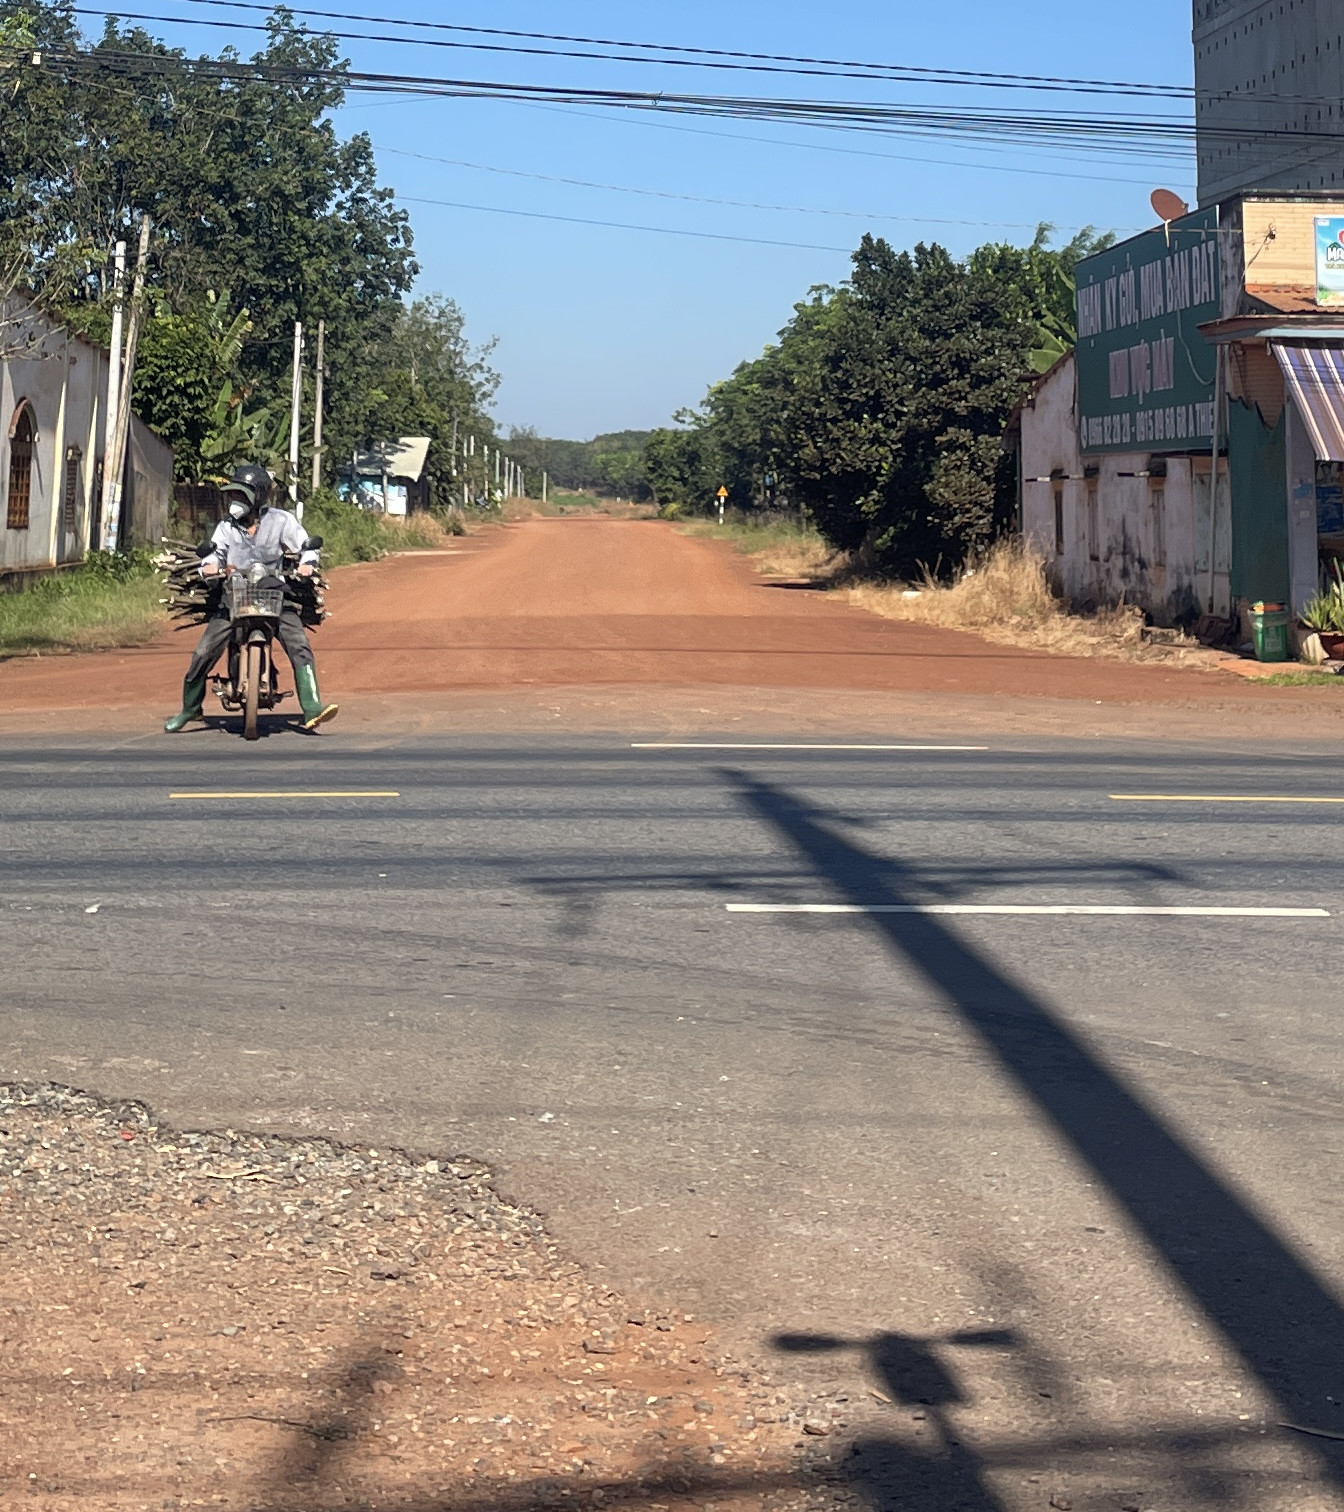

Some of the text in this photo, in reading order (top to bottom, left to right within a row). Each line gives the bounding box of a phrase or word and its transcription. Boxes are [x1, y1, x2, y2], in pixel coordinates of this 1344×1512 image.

[1104, 265, 1117, 332] KÝ
[1140, 259, 1165, 322] MUA
[1165, 239, 1190, 313] BÁN
[1191, 219, 1215, 306] ĐẤT
